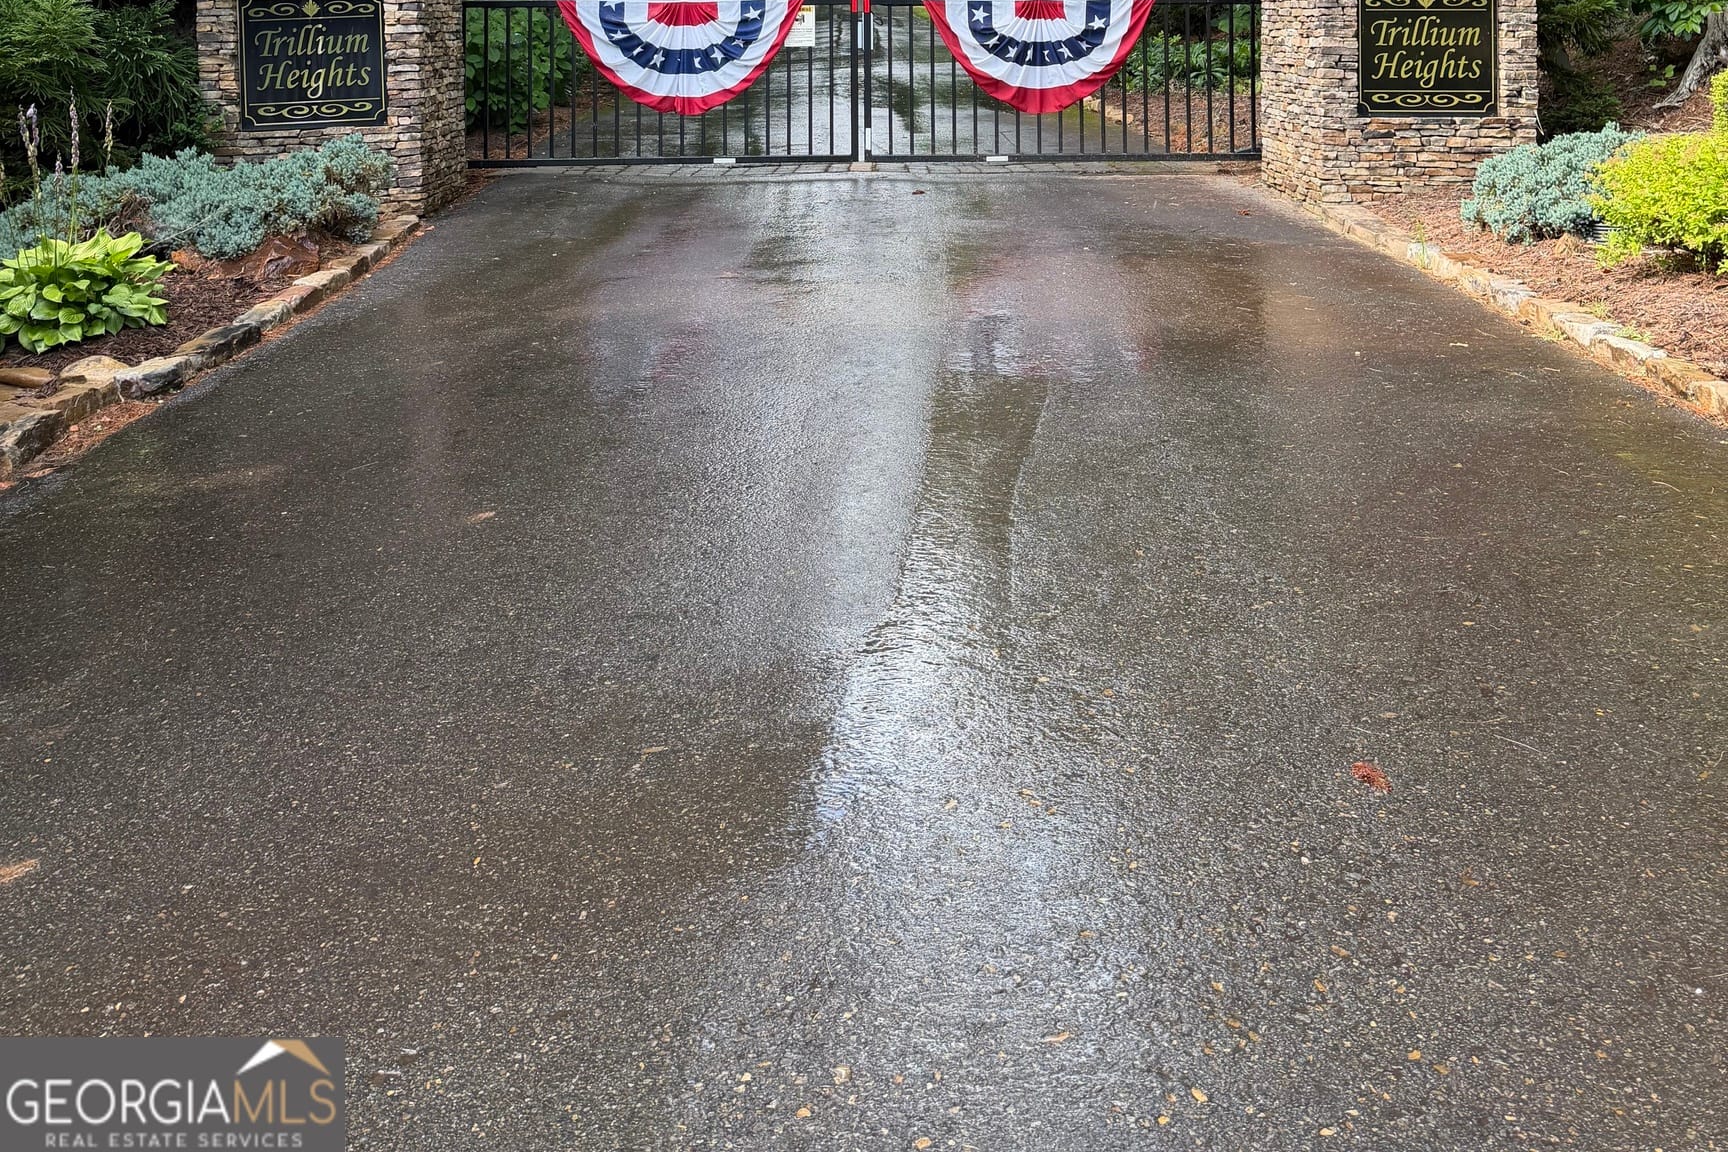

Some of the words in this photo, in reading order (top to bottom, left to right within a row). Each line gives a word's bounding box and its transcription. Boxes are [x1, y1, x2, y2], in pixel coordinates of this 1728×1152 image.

[254, 23, 370, 57] Trillium
[1370, 15, 1481, 47] Trillium
[256, 56, 372, 99] Heights
[1371, 48, 1483, 89] Heights
